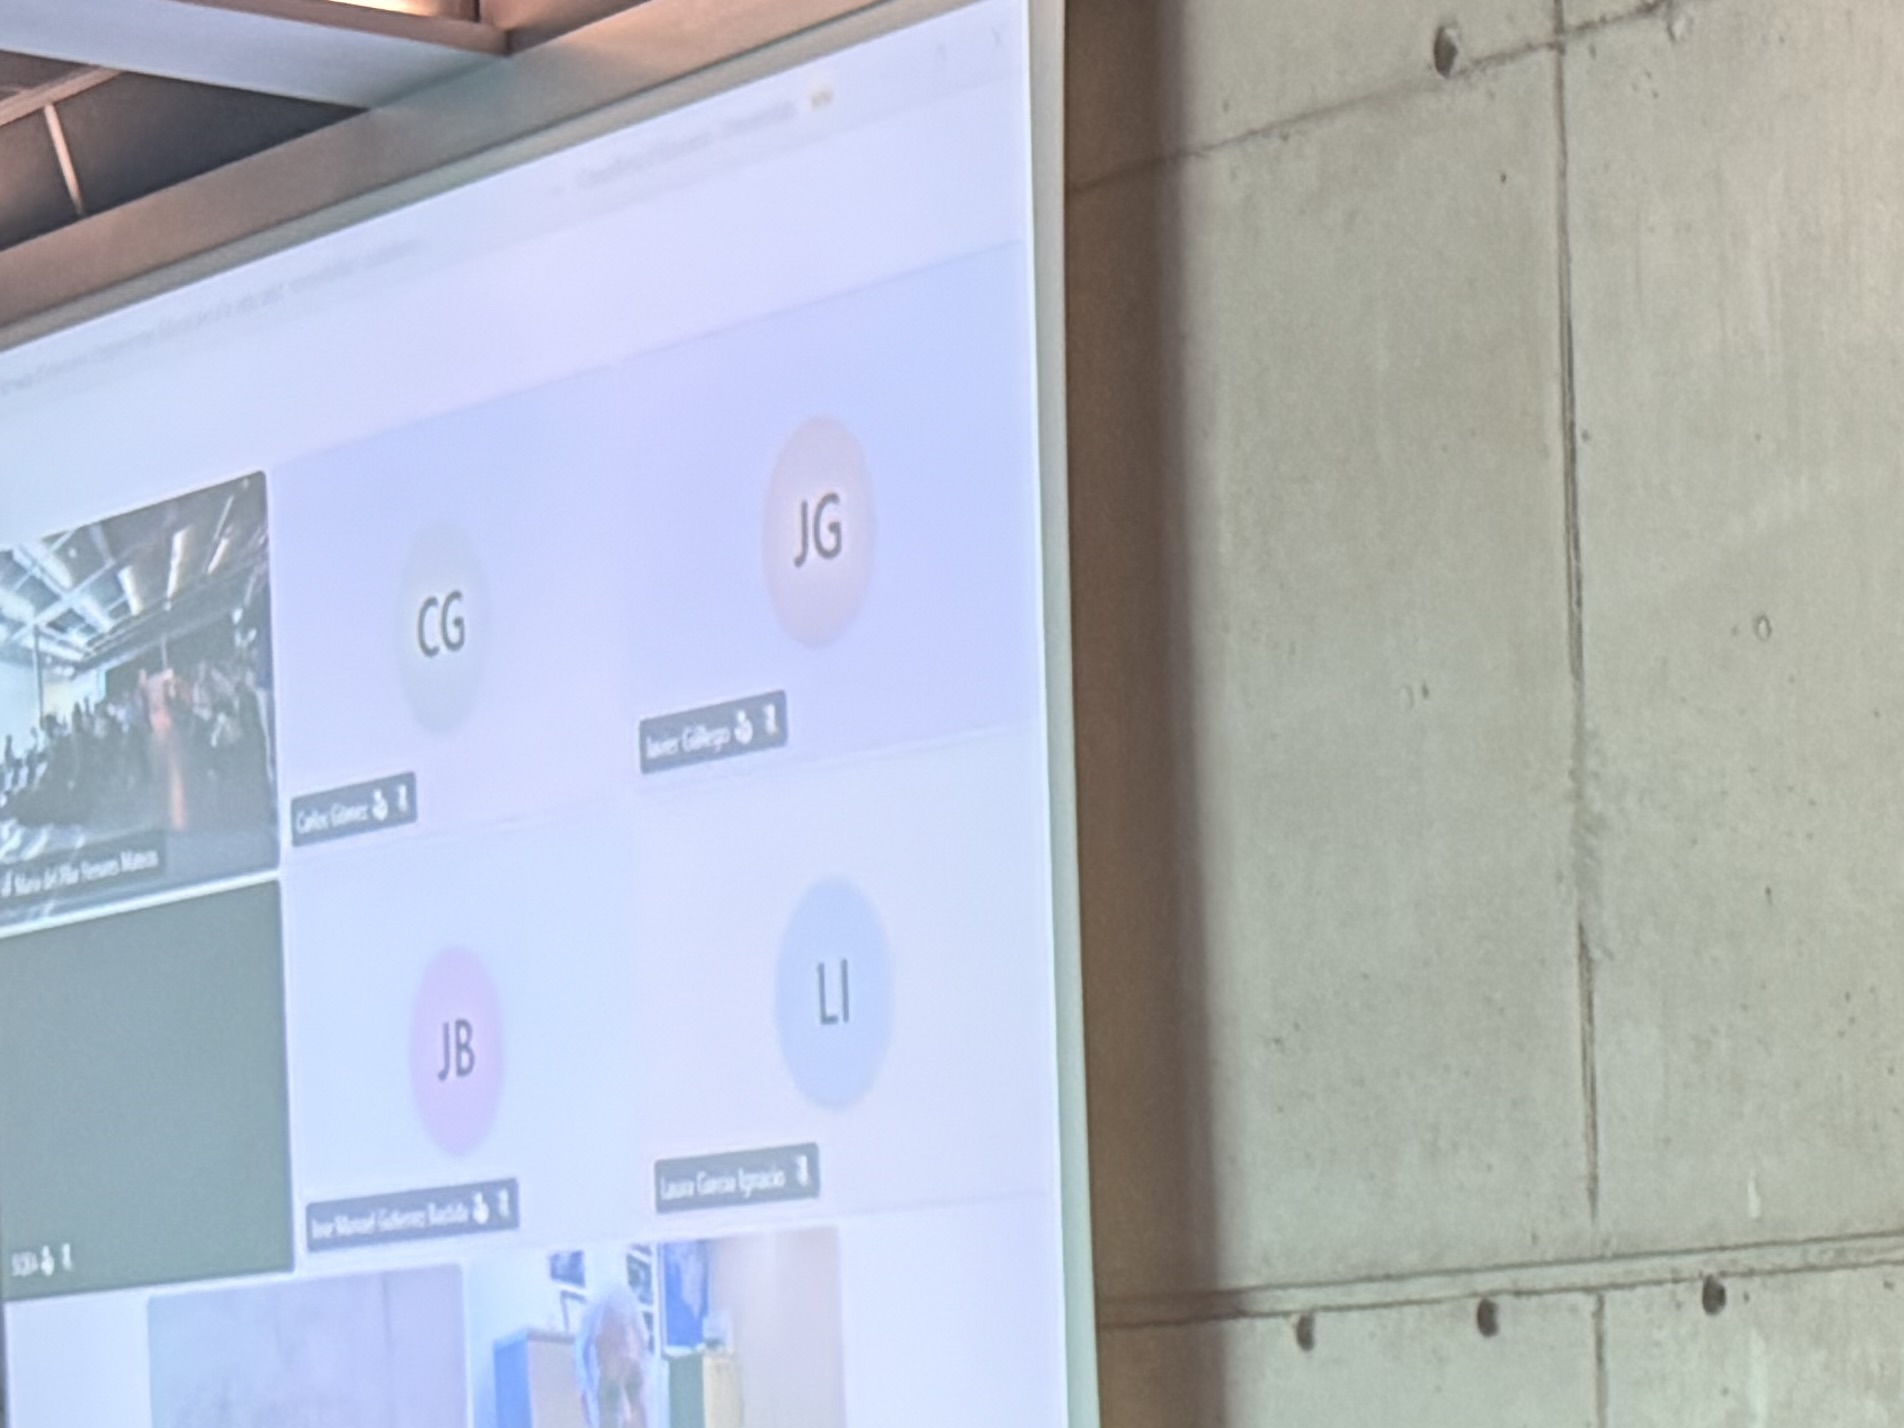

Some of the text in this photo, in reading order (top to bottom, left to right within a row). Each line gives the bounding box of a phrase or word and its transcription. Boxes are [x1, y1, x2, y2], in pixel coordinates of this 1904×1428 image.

[793, 492, 842, 568] JG
[417, 590, 465, 658] CG
[816, 958, 849, 1026] LI
[438, 1018, 475, 1082] JB
